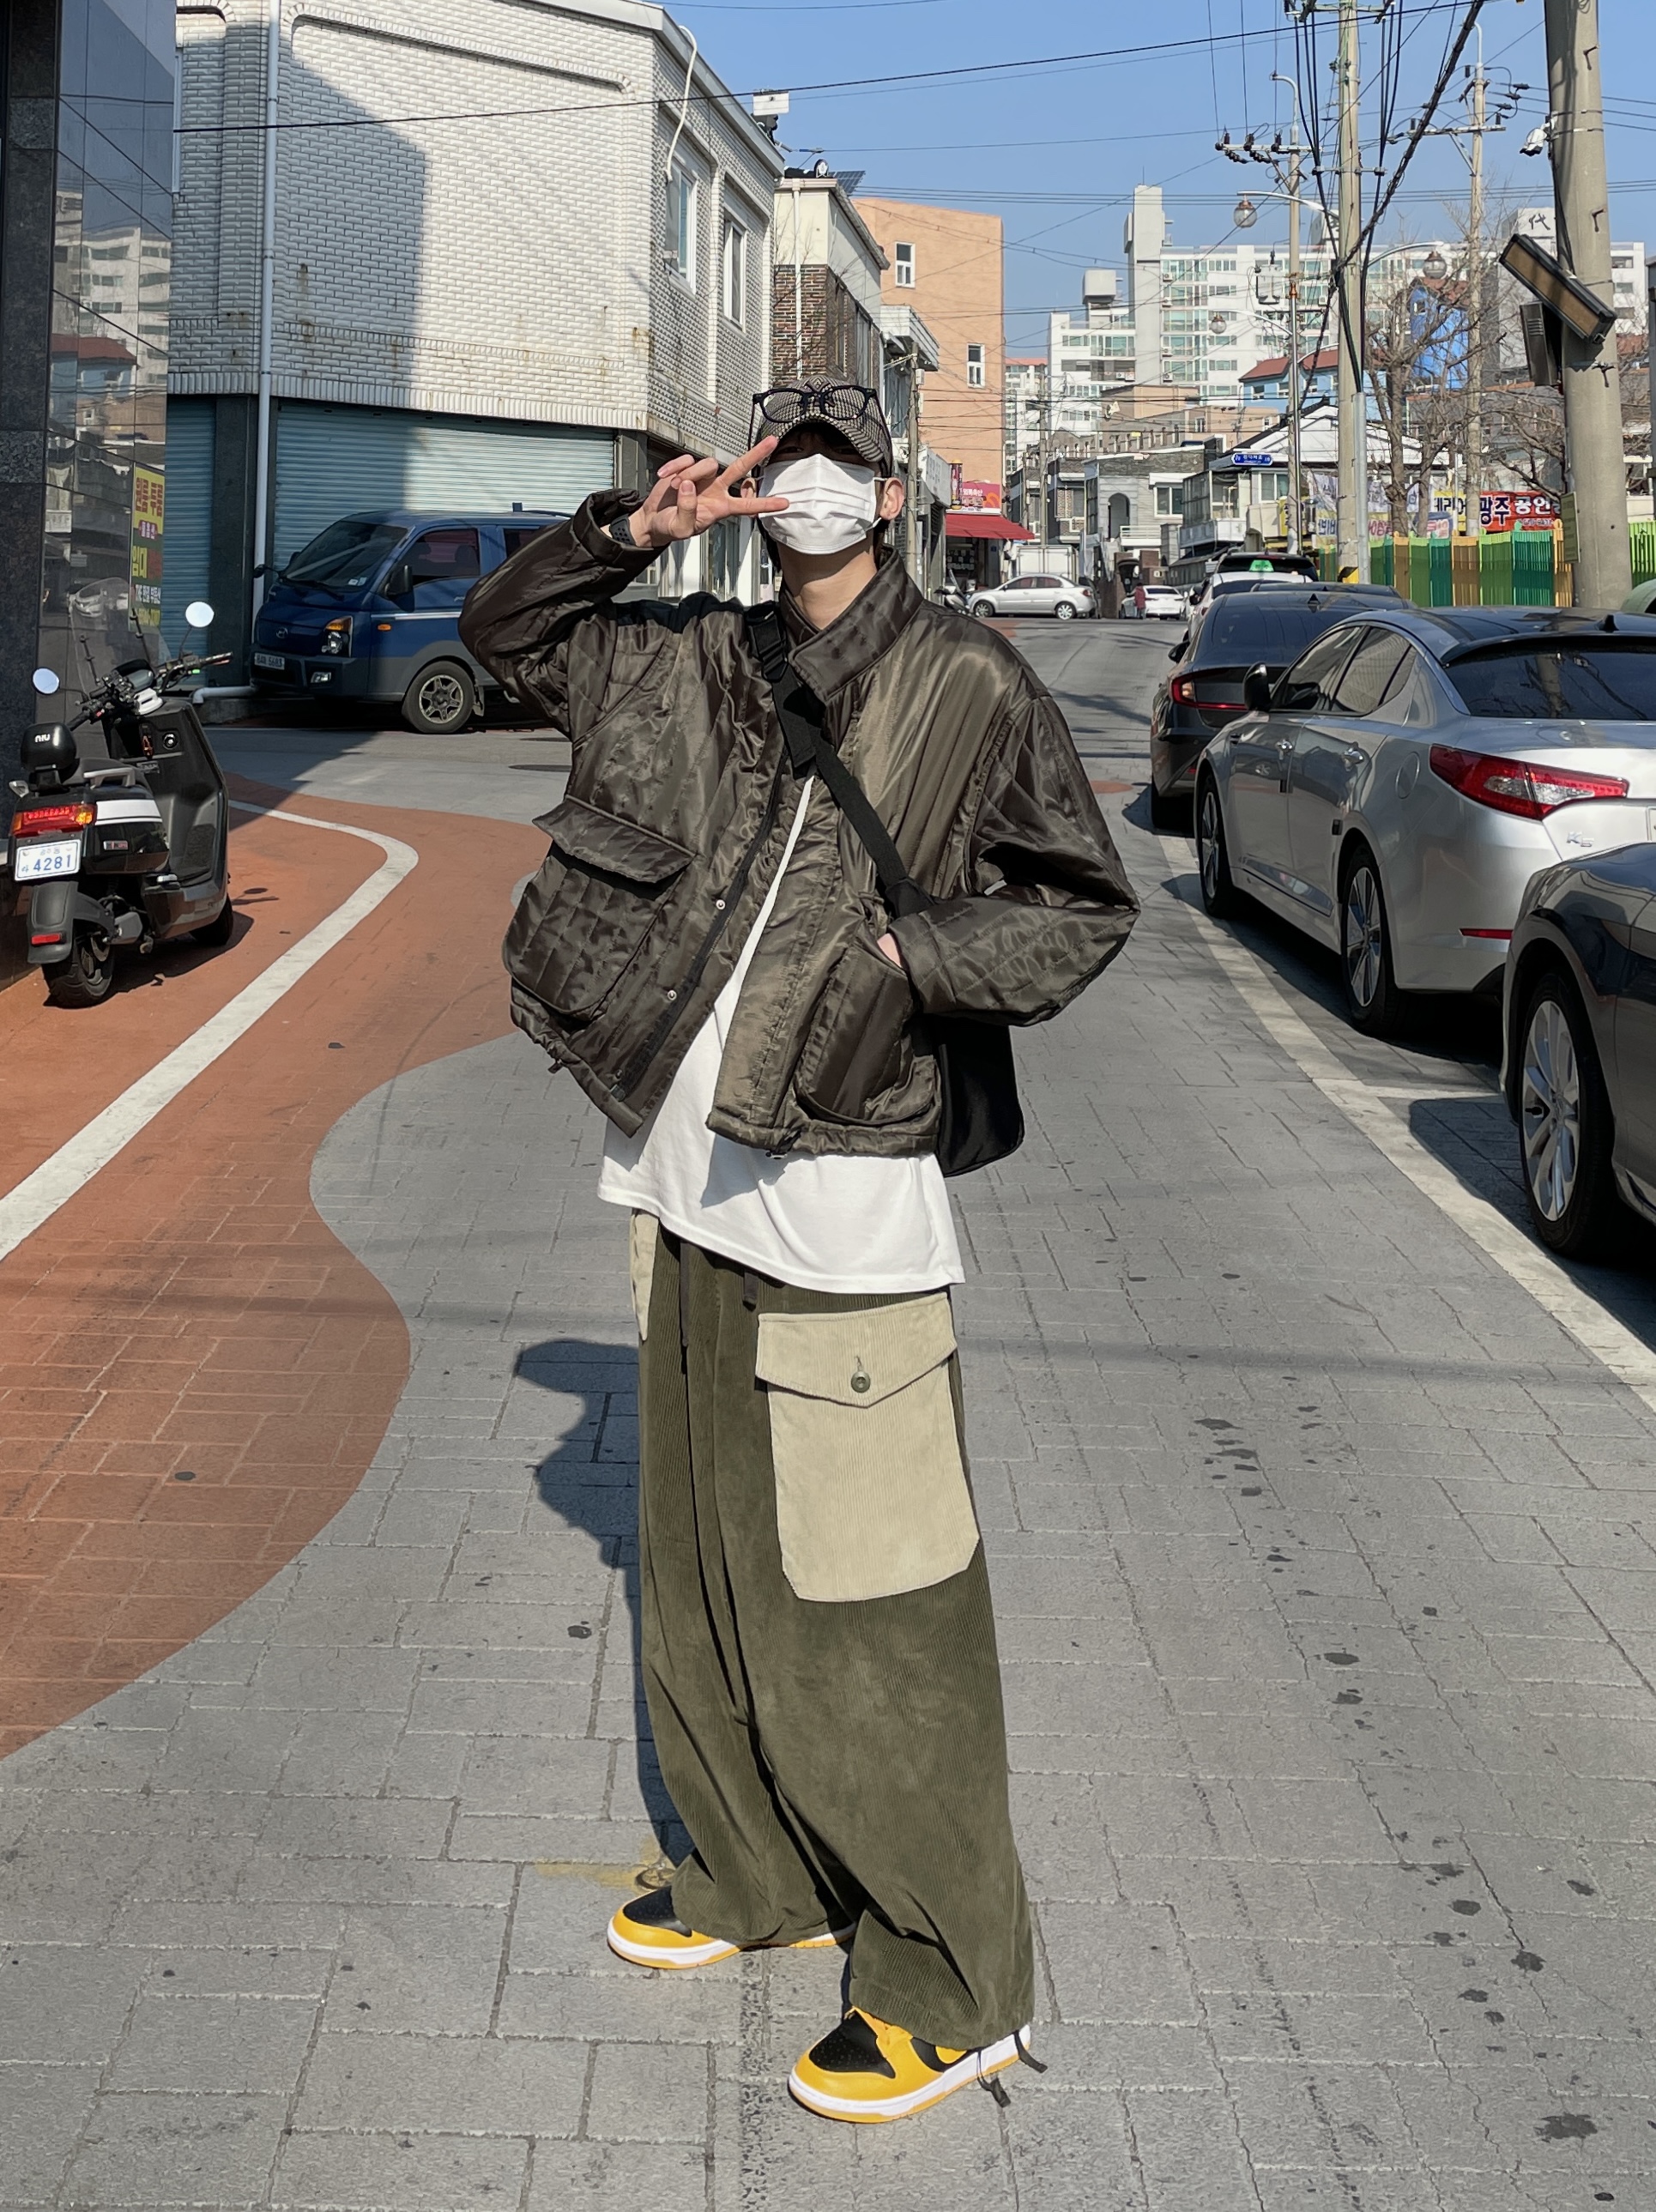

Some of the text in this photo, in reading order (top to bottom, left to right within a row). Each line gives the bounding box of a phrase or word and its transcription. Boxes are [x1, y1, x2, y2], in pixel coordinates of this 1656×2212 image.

[1528, 213, 1550, 230] 代
[1479, 496, 1510, 525] 광주
[131, 546, 148, 578] 임대
[1566, 831, 1594, 847] K5
[33, 854, 71, 872] 4281
